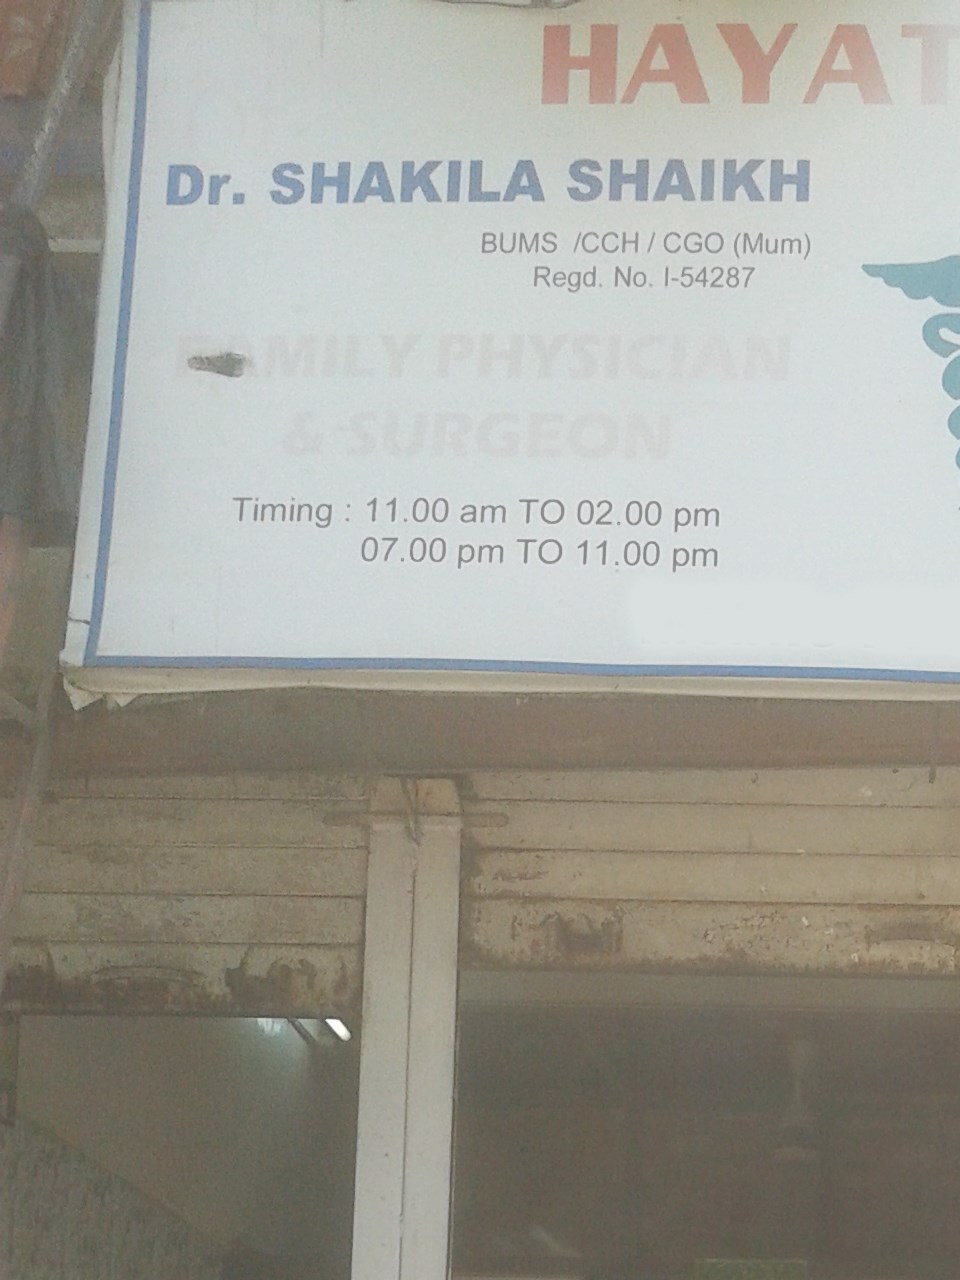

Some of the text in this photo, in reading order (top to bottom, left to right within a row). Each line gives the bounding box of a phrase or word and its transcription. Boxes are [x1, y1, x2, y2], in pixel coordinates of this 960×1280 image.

[167, 159, 811, 206] Dr. SHAKILA SHAIKH
[481, 232, 559, 255] BUMS
[664, 232, 726, 255] CGO
[733, 232, 812, 260] (Mum)
[533, 266, 757, 293] Regd. No. I-54287
[436, 333, 792, 382] PHYSICIAN
[282, 410, 672, 460] & SURGEON
[233, 497, 334, 530] Timing
[368, 498, 451, 524] 11.00
[461, 505, 508, 525] am
[519, 499, 566, 525] TO
[576, 500, 663, 527] 02.00
[674, 508, 721, 533] pm
[360, 537, 719, 574] 07.00 pm TO 11.00 pm
